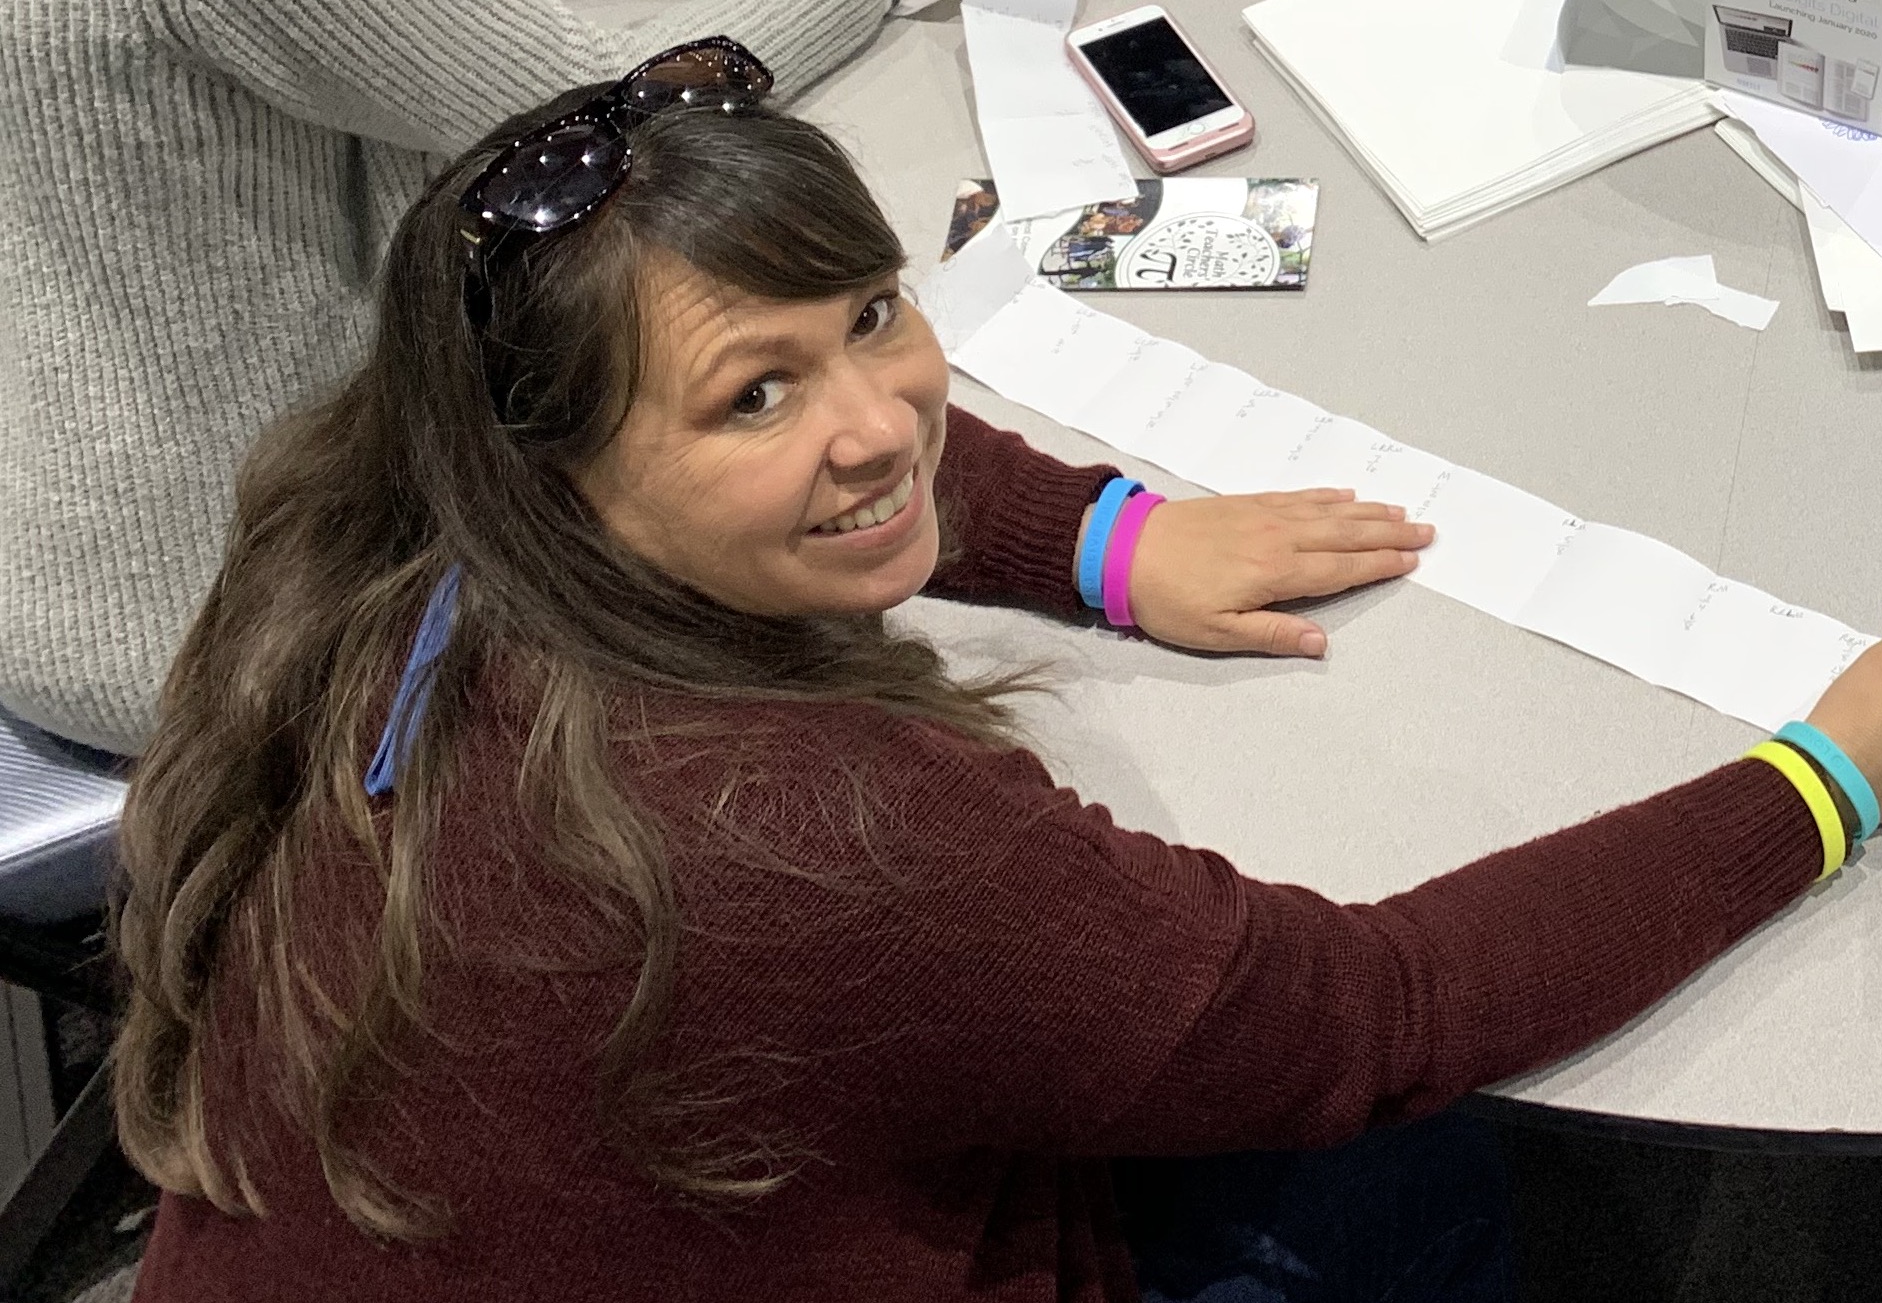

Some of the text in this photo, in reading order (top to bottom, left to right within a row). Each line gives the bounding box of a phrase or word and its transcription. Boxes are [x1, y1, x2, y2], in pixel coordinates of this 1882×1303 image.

[1769, 0, 1878, 40] Launching January 2020
[1830, 1, 1879, 29] Digital
[1182, 247, 1200, 279] Circle
[1197, 228, 1219, 281] Teachers'
[1211, 250, 1227, 279] Math
